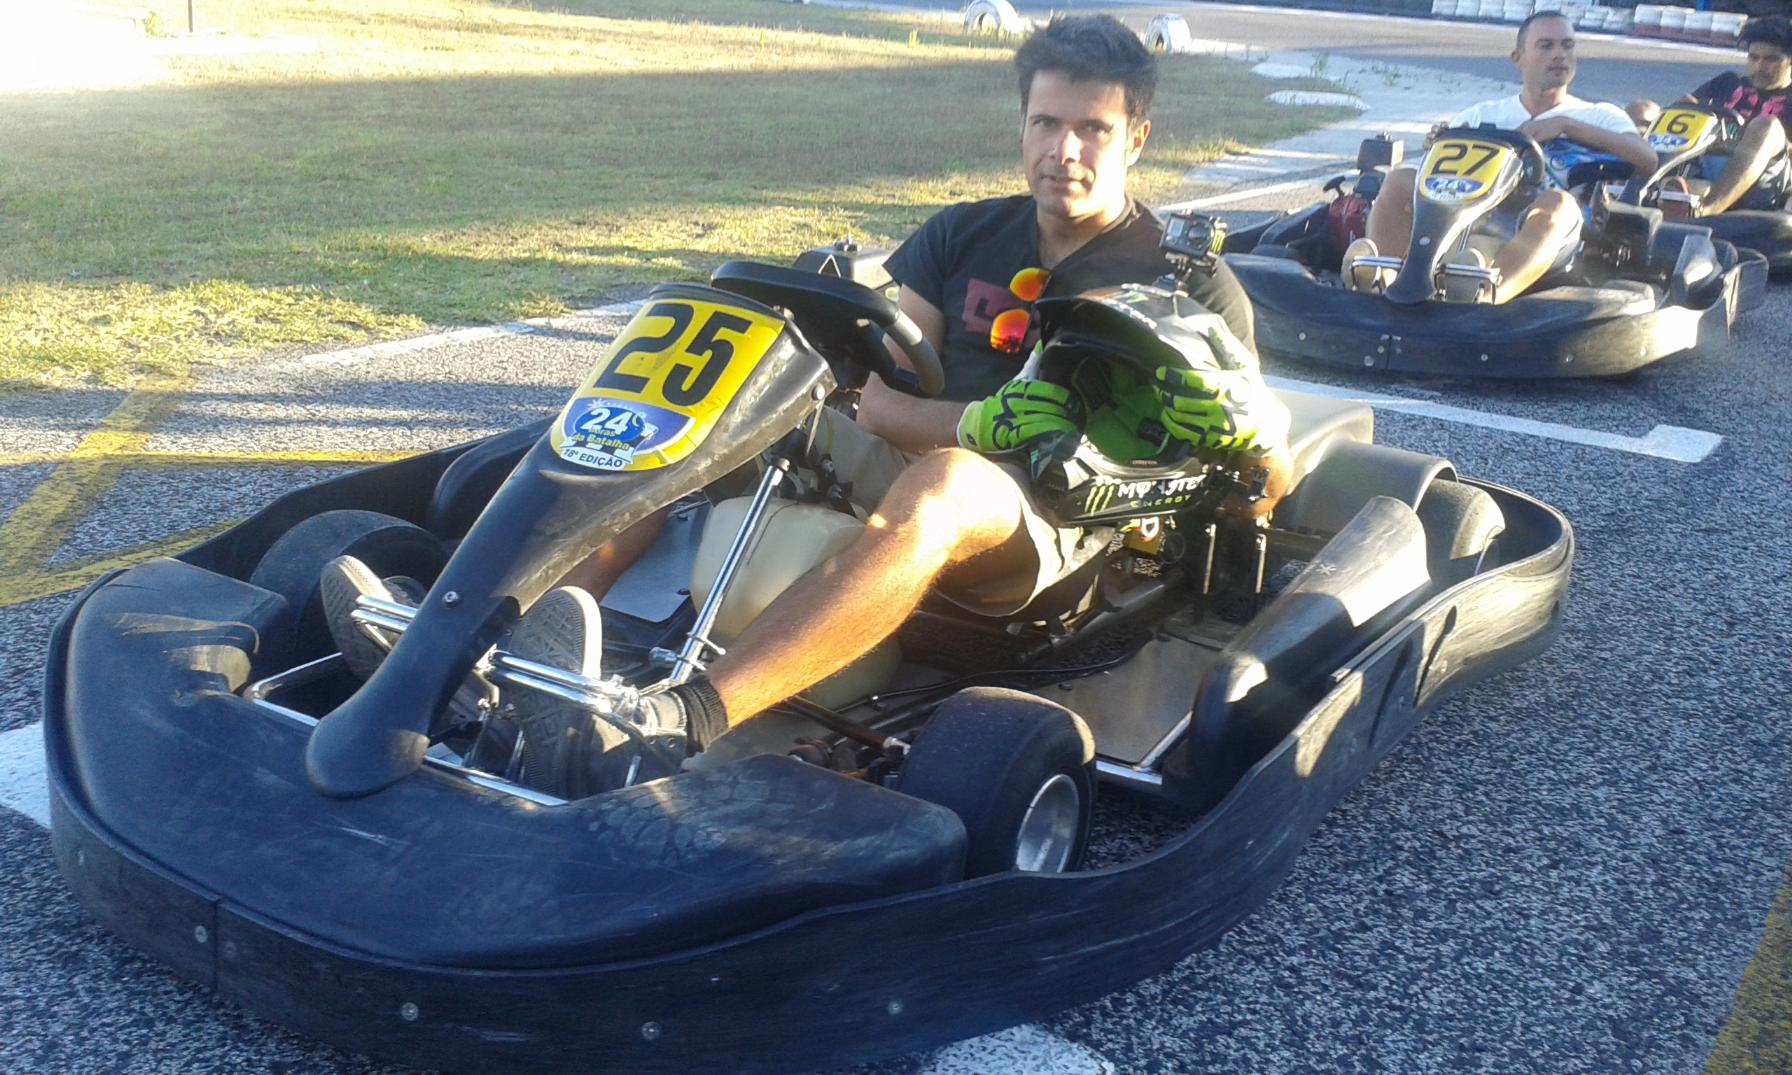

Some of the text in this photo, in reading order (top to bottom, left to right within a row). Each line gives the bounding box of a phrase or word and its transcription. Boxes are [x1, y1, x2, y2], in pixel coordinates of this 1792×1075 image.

[1430, 143, 1500, 176] 27
[592, 303, 752, 407] 25
[580, 407, 633, 435] 24
[586, 433, 631, 451] Batalha
[579, 453, 623, 468] EDIÇÃO
